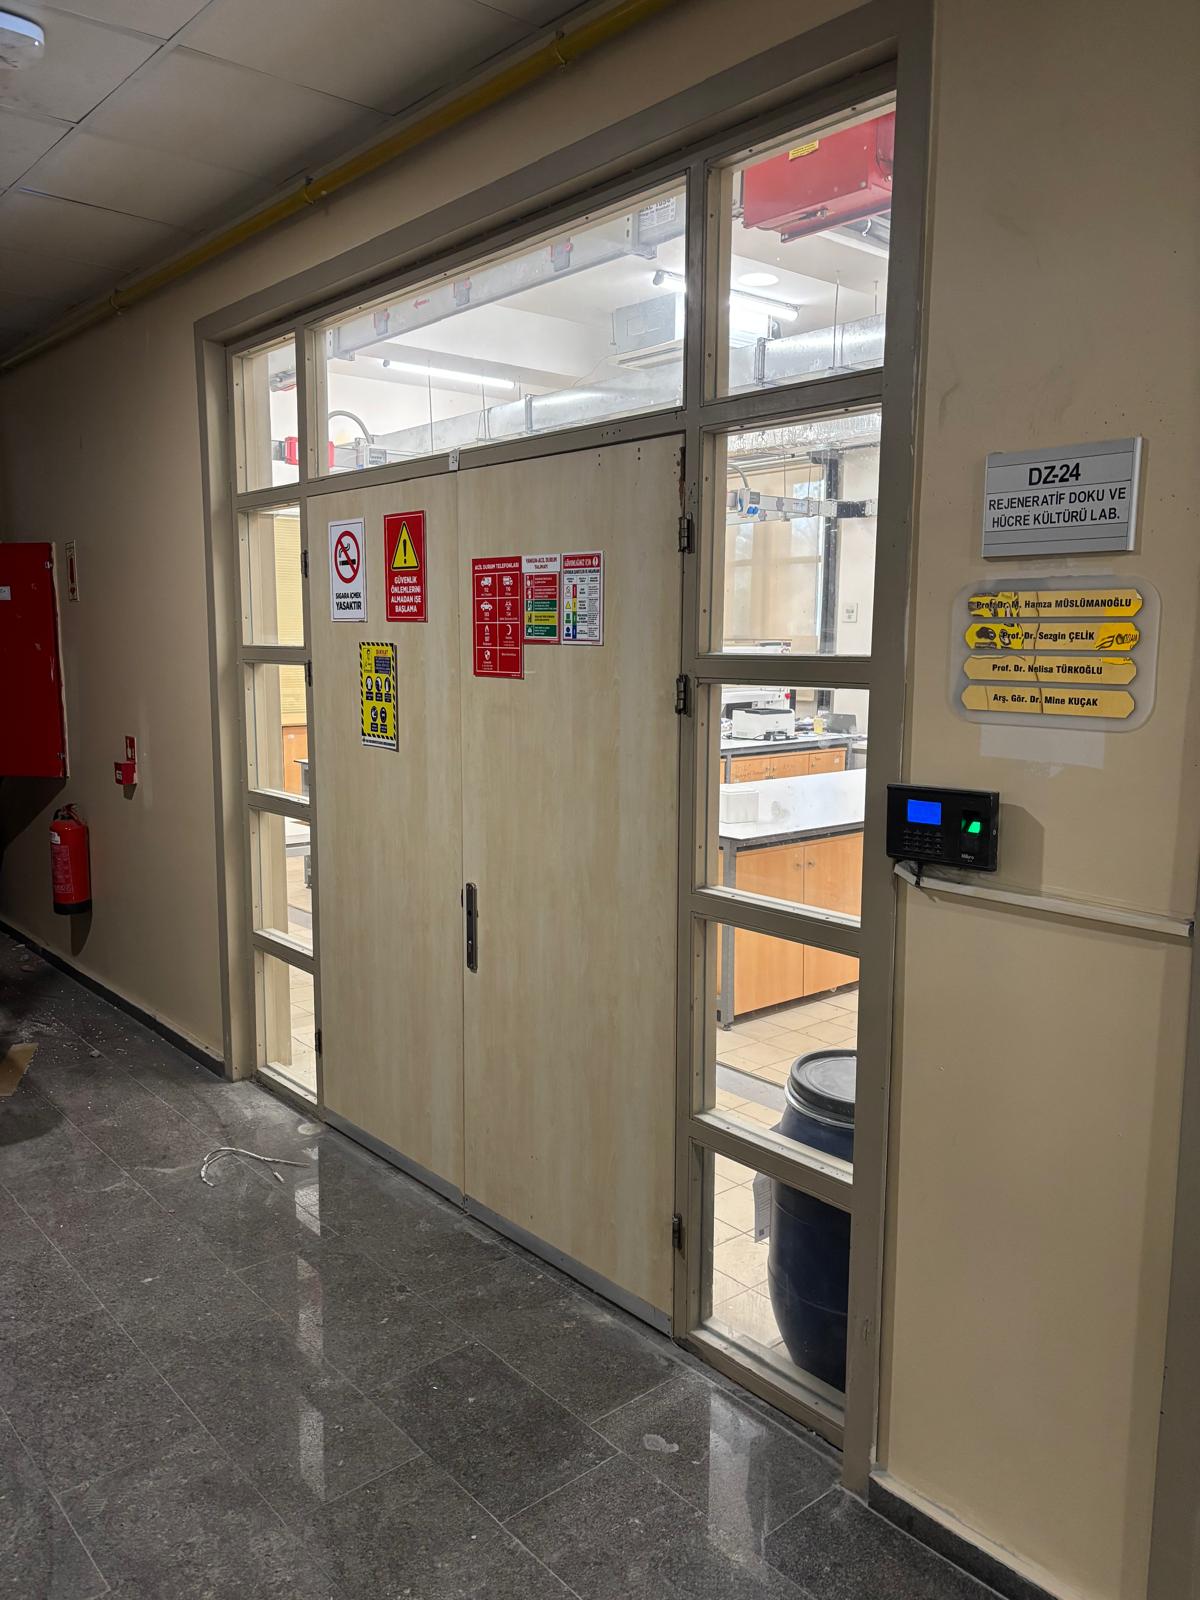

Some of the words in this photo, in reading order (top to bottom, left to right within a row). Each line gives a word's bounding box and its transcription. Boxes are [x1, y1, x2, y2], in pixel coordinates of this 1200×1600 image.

[1028, 462, 1081, 486] DZ-24
[988, 490, 1066, 511] REJENERATİF
[1068, 489, 1105, 504] DOKU
[1109, 487, 1127, 500] VE
[992, 514, 1030, 528] HÜCRE
[1033, 508, 1088, 525] KÜLTÜRÜ
[1090, 507, 1120, 521] LAB.
[1024, 600, 1052, 609] Hamza
[1054, 597, 1132, 608] MÜSLÜMANOĞLU
[1038, 631, 1066, 642] Sezgin
[1068, 630, 1095, 642] ÇELİK
[992, 664, 1012, 672] Prof.
[1013, 665, 1026, 673] Dr.
[1028, 665, 1054, 674] Nelisa
[1056, 664, 1103, 675] TÜRKOĞLU
[992, 693, 1009, 704] Arş.
[1011, 694, 1027, 703] Gör.
[1030, 695, 1042, 704] Dr.
[1044, 696, 1066, 705] Mine
[1068, 697, 1099, 708] KUÇAK
